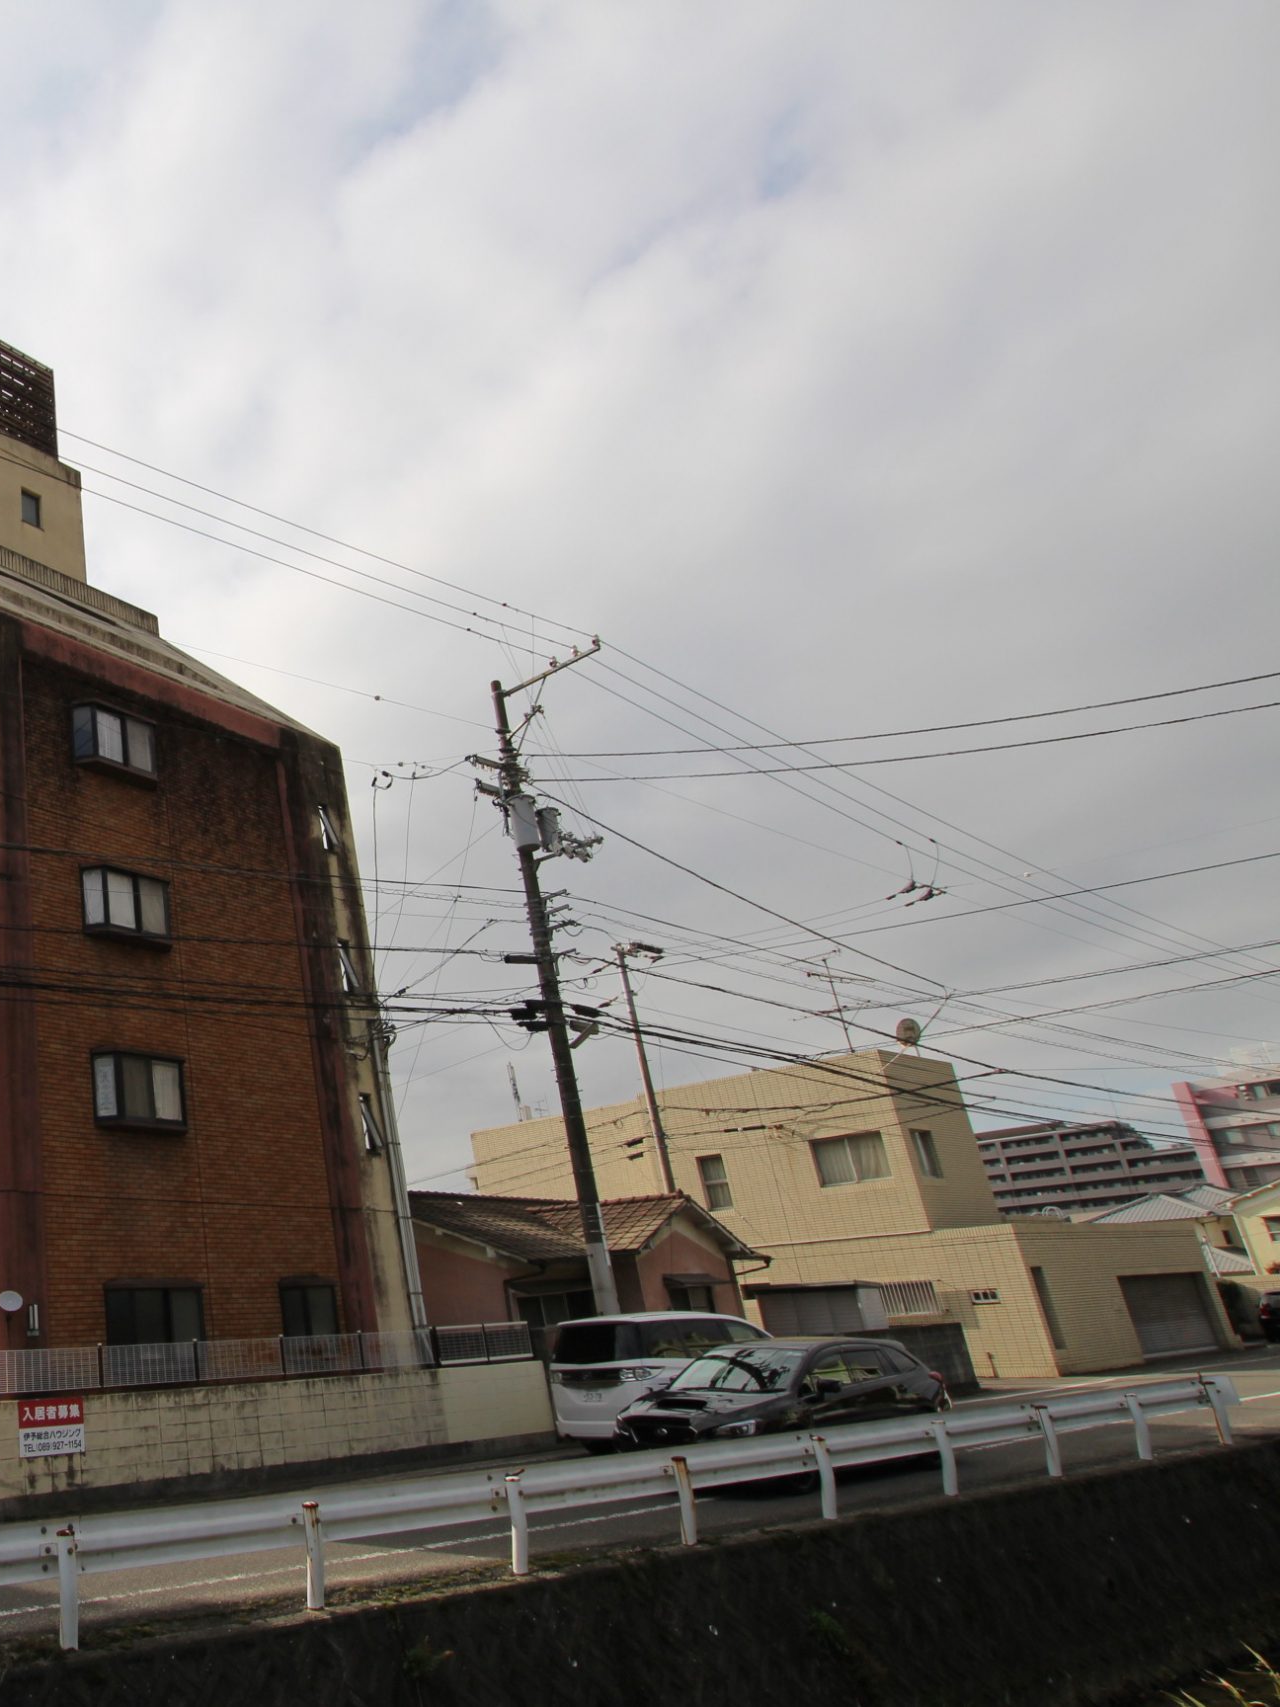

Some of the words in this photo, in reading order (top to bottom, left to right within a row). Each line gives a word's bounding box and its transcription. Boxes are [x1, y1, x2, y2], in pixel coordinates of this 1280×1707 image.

[23, 1404, 80, 1421] 入居者募集
